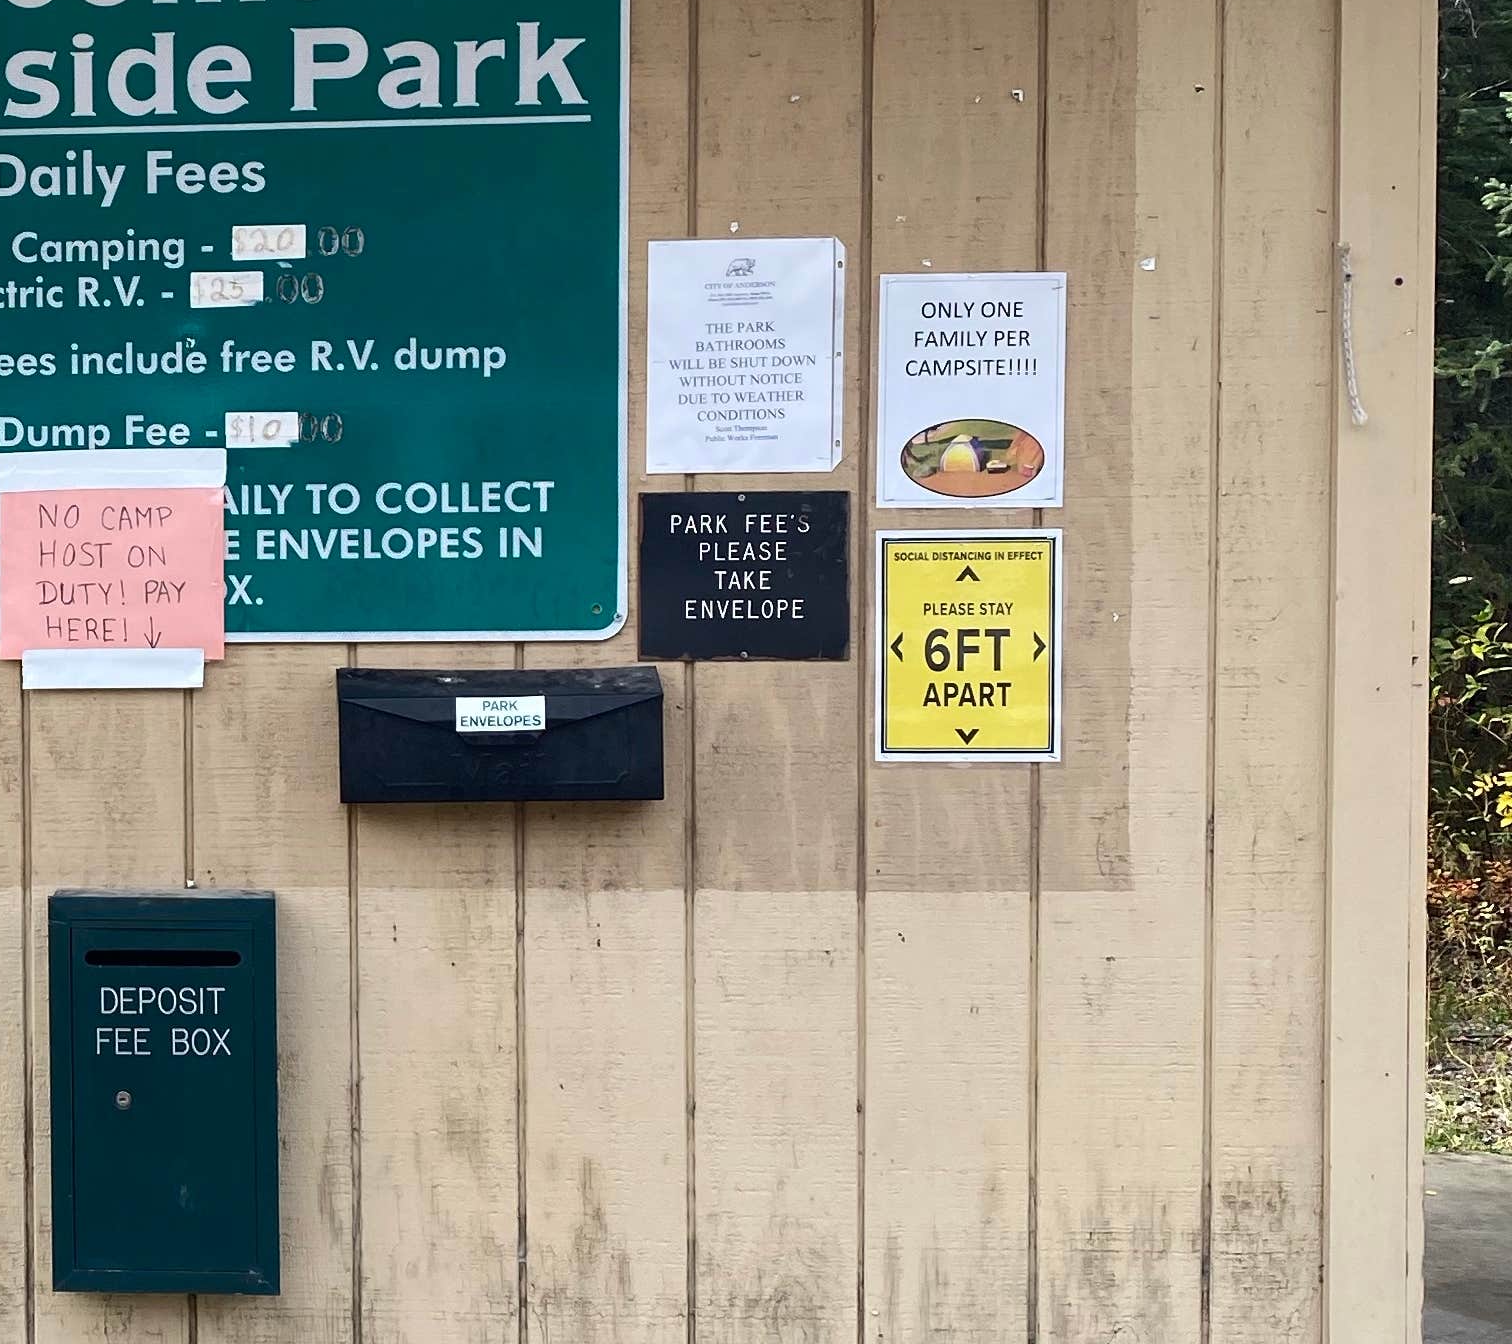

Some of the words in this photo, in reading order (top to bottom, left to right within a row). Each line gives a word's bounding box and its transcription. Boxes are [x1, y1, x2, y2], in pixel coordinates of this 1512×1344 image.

[289, 22, 591, 113] Park
[147, 150, 266, 194] Fees
[11, 229, 185, 270] Camping
[78, 276, 145, 307] R.V.
[921, 301, 975, 319] ONLY
[981, 301, 1024, 318] ONE
[705, 322, 734, 335] THE
[737, 320, 775, 334] PARK
[695, 337, 786, 353] BATHROOMS
[914, 330, 988, 348] FAMILY
[994, 330, 1031, 347] PER
[70, 340, 207, 375] include
[220, 339, 296, 373] free
[311, 340, 379, 371] R.V.
[394, 338, 507, 378] dump
[668, 358, 705, 371] WILL
[708, 357, 726, 370] BE
[730, 356, 768, 369] SHUT
[771, 354, 816, 368] DOWN
[905, 358, 1038, 377] CAMPSITE!!!!
[679, 374, 747, 388] WITHOUT
[749, 372, 803, 385] NOTICE
[678, 392, 707, 406] DUE
[711, 391, 731, 405] TO
[734, 389, 805, 404] WEATHER
[697, 407, 786, 422] CONDITIONS
[125, 414, 191, 447] Fee
[224, 484, 294, 515] AILY
[305, 483, 361, 515] TO
[375, 481, 555, 515] COLLECT
[38, 503, 80, 529] NO
[101, 505, 173, 531] CAMP
[670, 514, 728, 534] PARK
[745, 513, 811, 534] FEE'S
[256, 527, 484, 560] ENVELOPES
[500, 527, 542, 558] IN
[699, 541, 787, 561] PLEASE
[39, 540, 113, 569] HOST
[127, 545, 166, 569] ON
[894, 551, 930, 562] SOCIAL
[932, 551, 992, 561] DISTANCING
[994, 551, 1005, 561] IN
[1007, 551, 1044, 561] EFFECT
[714, 570, 772, 590] TAKE
[35, 579, 126, 606] DUTY!
[144, 579, 186, 605] PAY
[685, 599, 805, 620] ENVELOPE
[923, 602, 975, 616] PLEASE
[979, 602, 1014, 616] STAY
[46, 615, 128, 643] HERE!
[924, 628, 1011, 673] 6FT
[922, 682, 1012, 707] APART
[482, 700, 518, 712] PARK
[460, 714, 542, 727] ENVELOPES
[100, 986, 226, 1015] DEPOSIT
[96, 1027, 151, 1055] FEE
[171, 1027, 231, 1056] BOX
